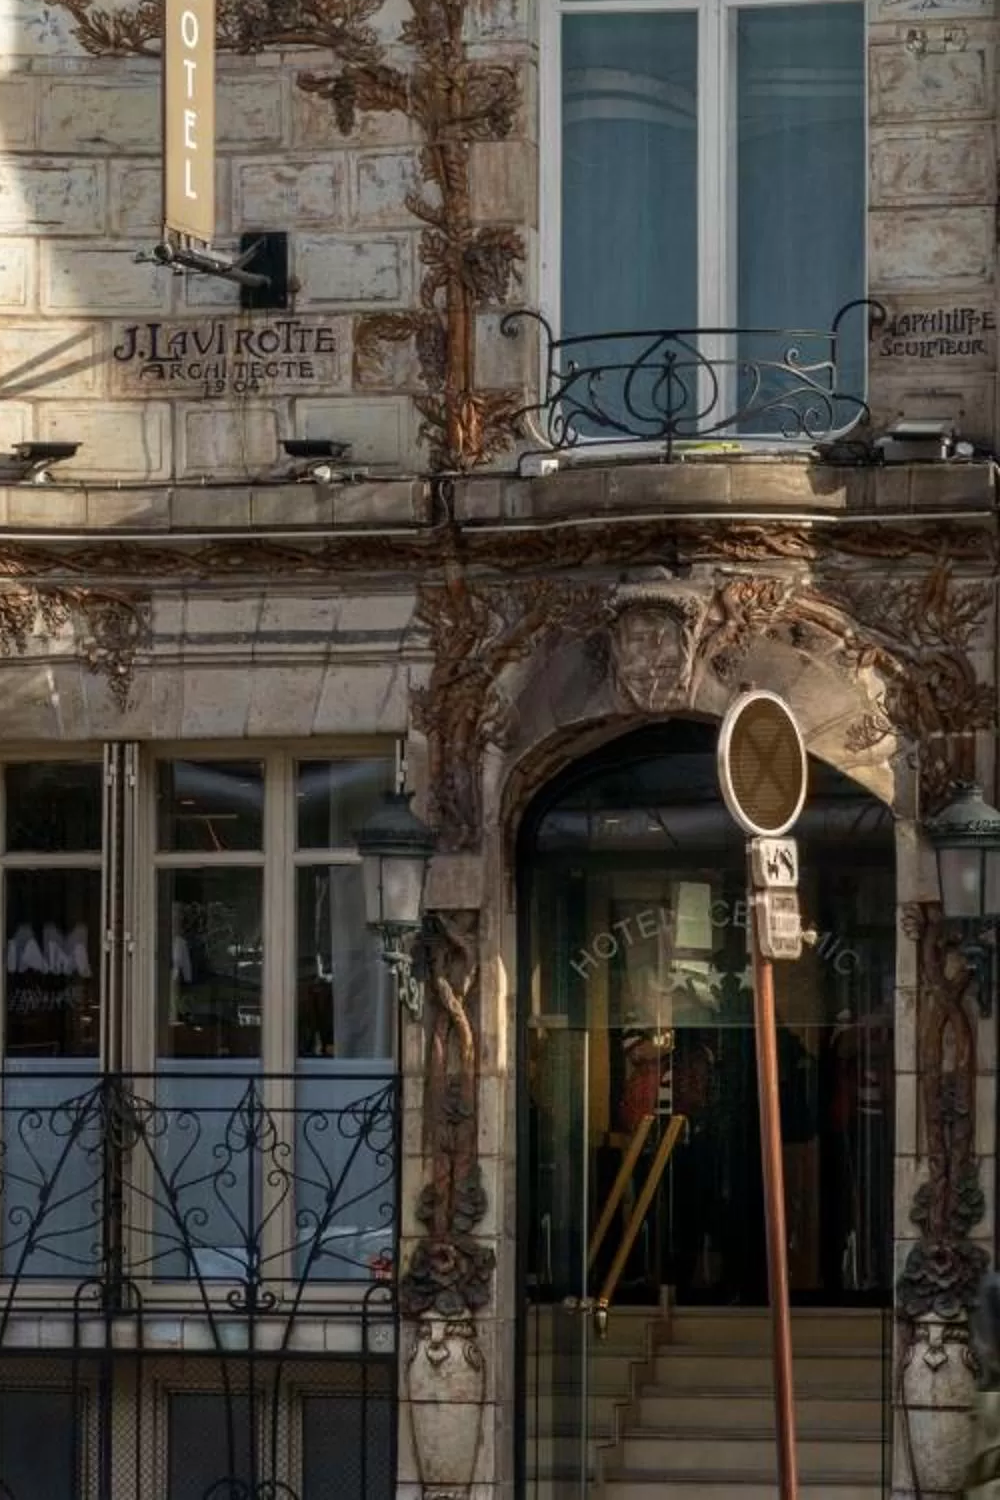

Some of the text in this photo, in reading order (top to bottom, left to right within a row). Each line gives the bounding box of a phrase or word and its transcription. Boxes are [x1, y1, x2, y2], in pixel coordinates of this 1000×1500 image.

[879, 337, 989, 358] SCULPTEUR
[569, 907, 676, 980] HOTEL
[710, 899, 861, 975] CEIC
